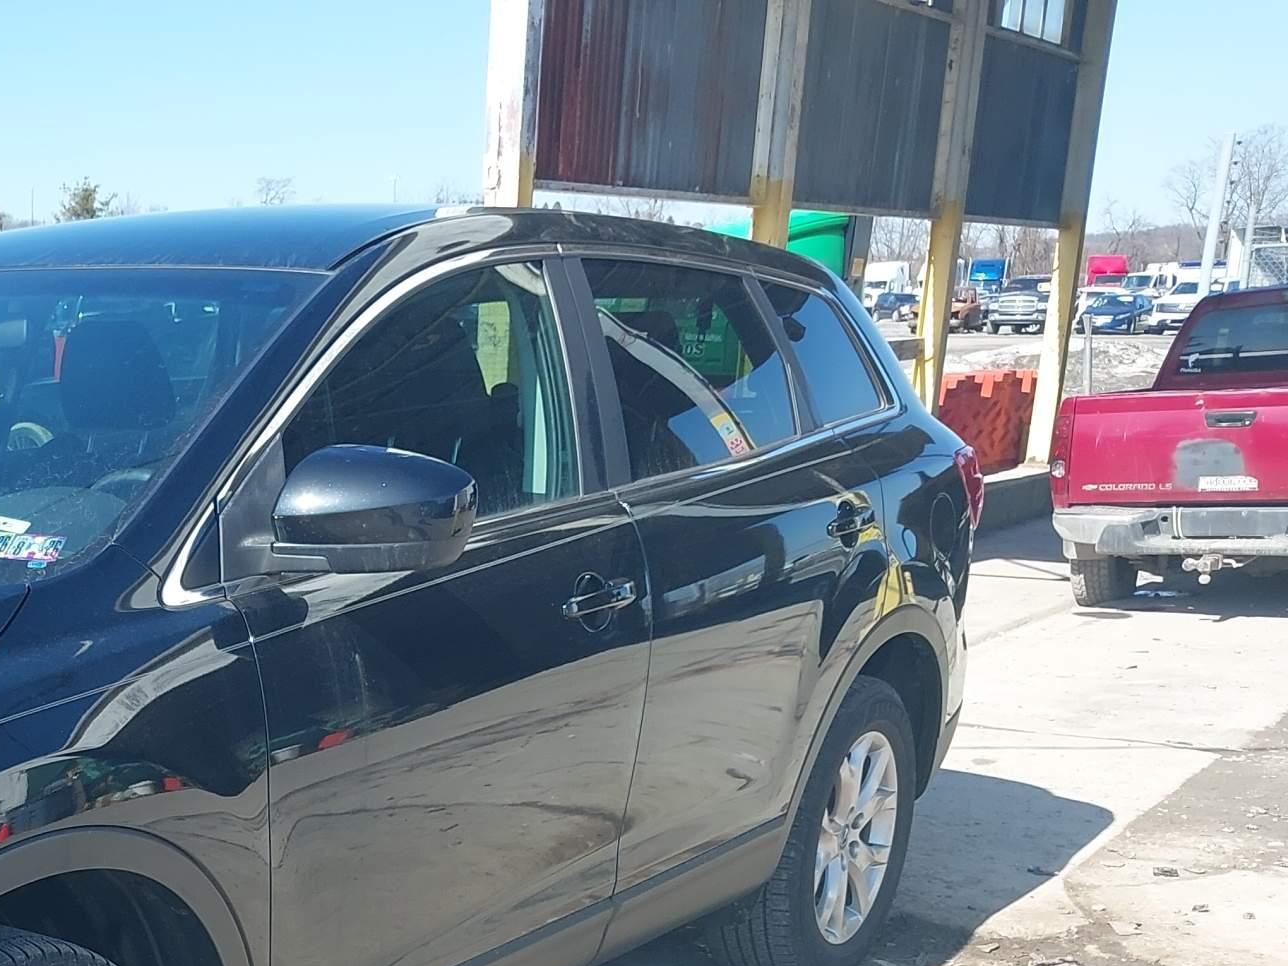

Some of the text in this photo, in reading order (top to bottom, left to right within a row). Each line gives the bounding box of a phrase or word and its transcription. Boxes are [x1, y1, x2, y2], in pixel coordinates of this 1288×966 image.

[1098, 482, 1173, 492] COLORADO LS
[12, 541, 26, 556] 8
